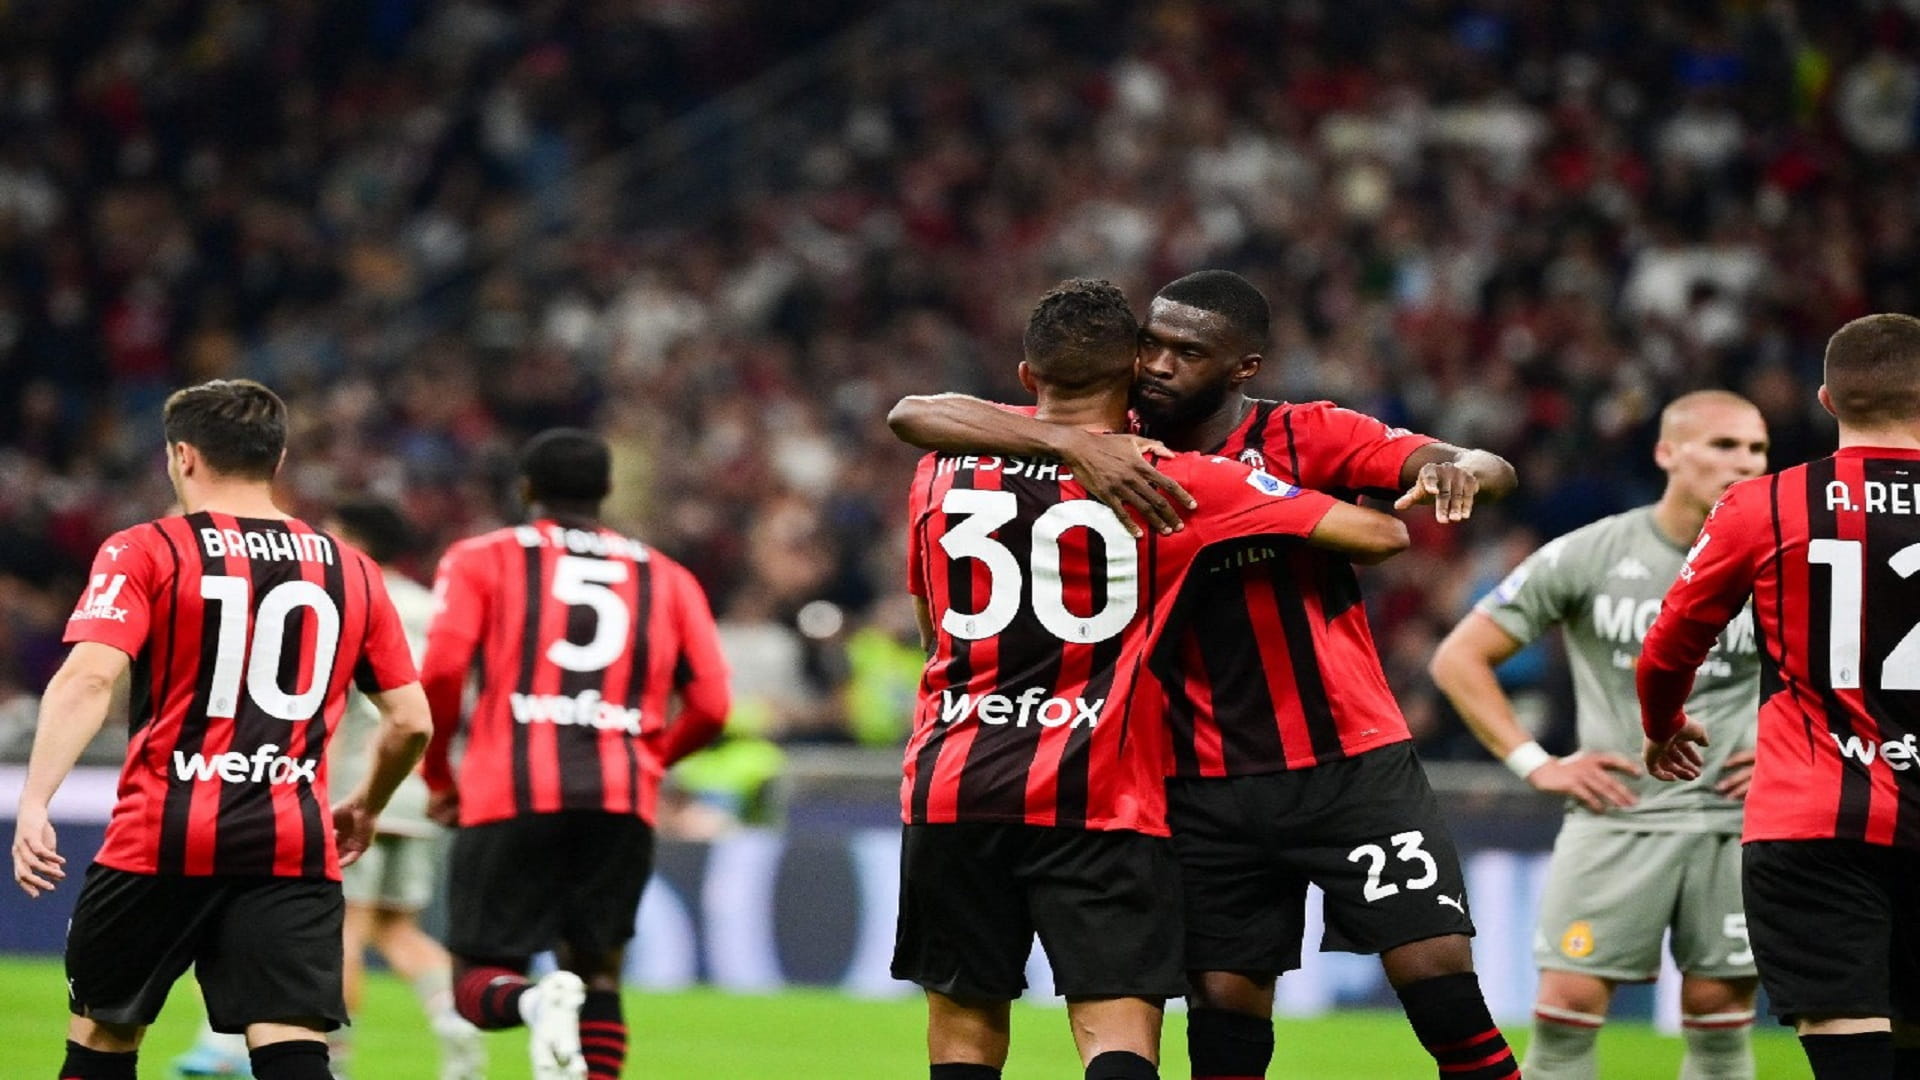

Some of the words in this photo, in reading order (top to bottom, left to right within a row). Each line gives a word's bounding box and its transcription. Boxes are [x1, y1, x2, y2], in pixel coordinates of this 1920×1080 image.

[200, 527, 334, 566] BRAHIM
[938, 487, 1139, 644] 30
[546, 554, 632, 672] 5
[200, 575, 340, 721] 10
[510, 689, 642, 735] wefox
[938, 687, 1105, 730] wefox
[173, 743, 317, 785] wefox
[1347, 830, 1439, 903] 23
[1723, 912, 1755, 966] 5
